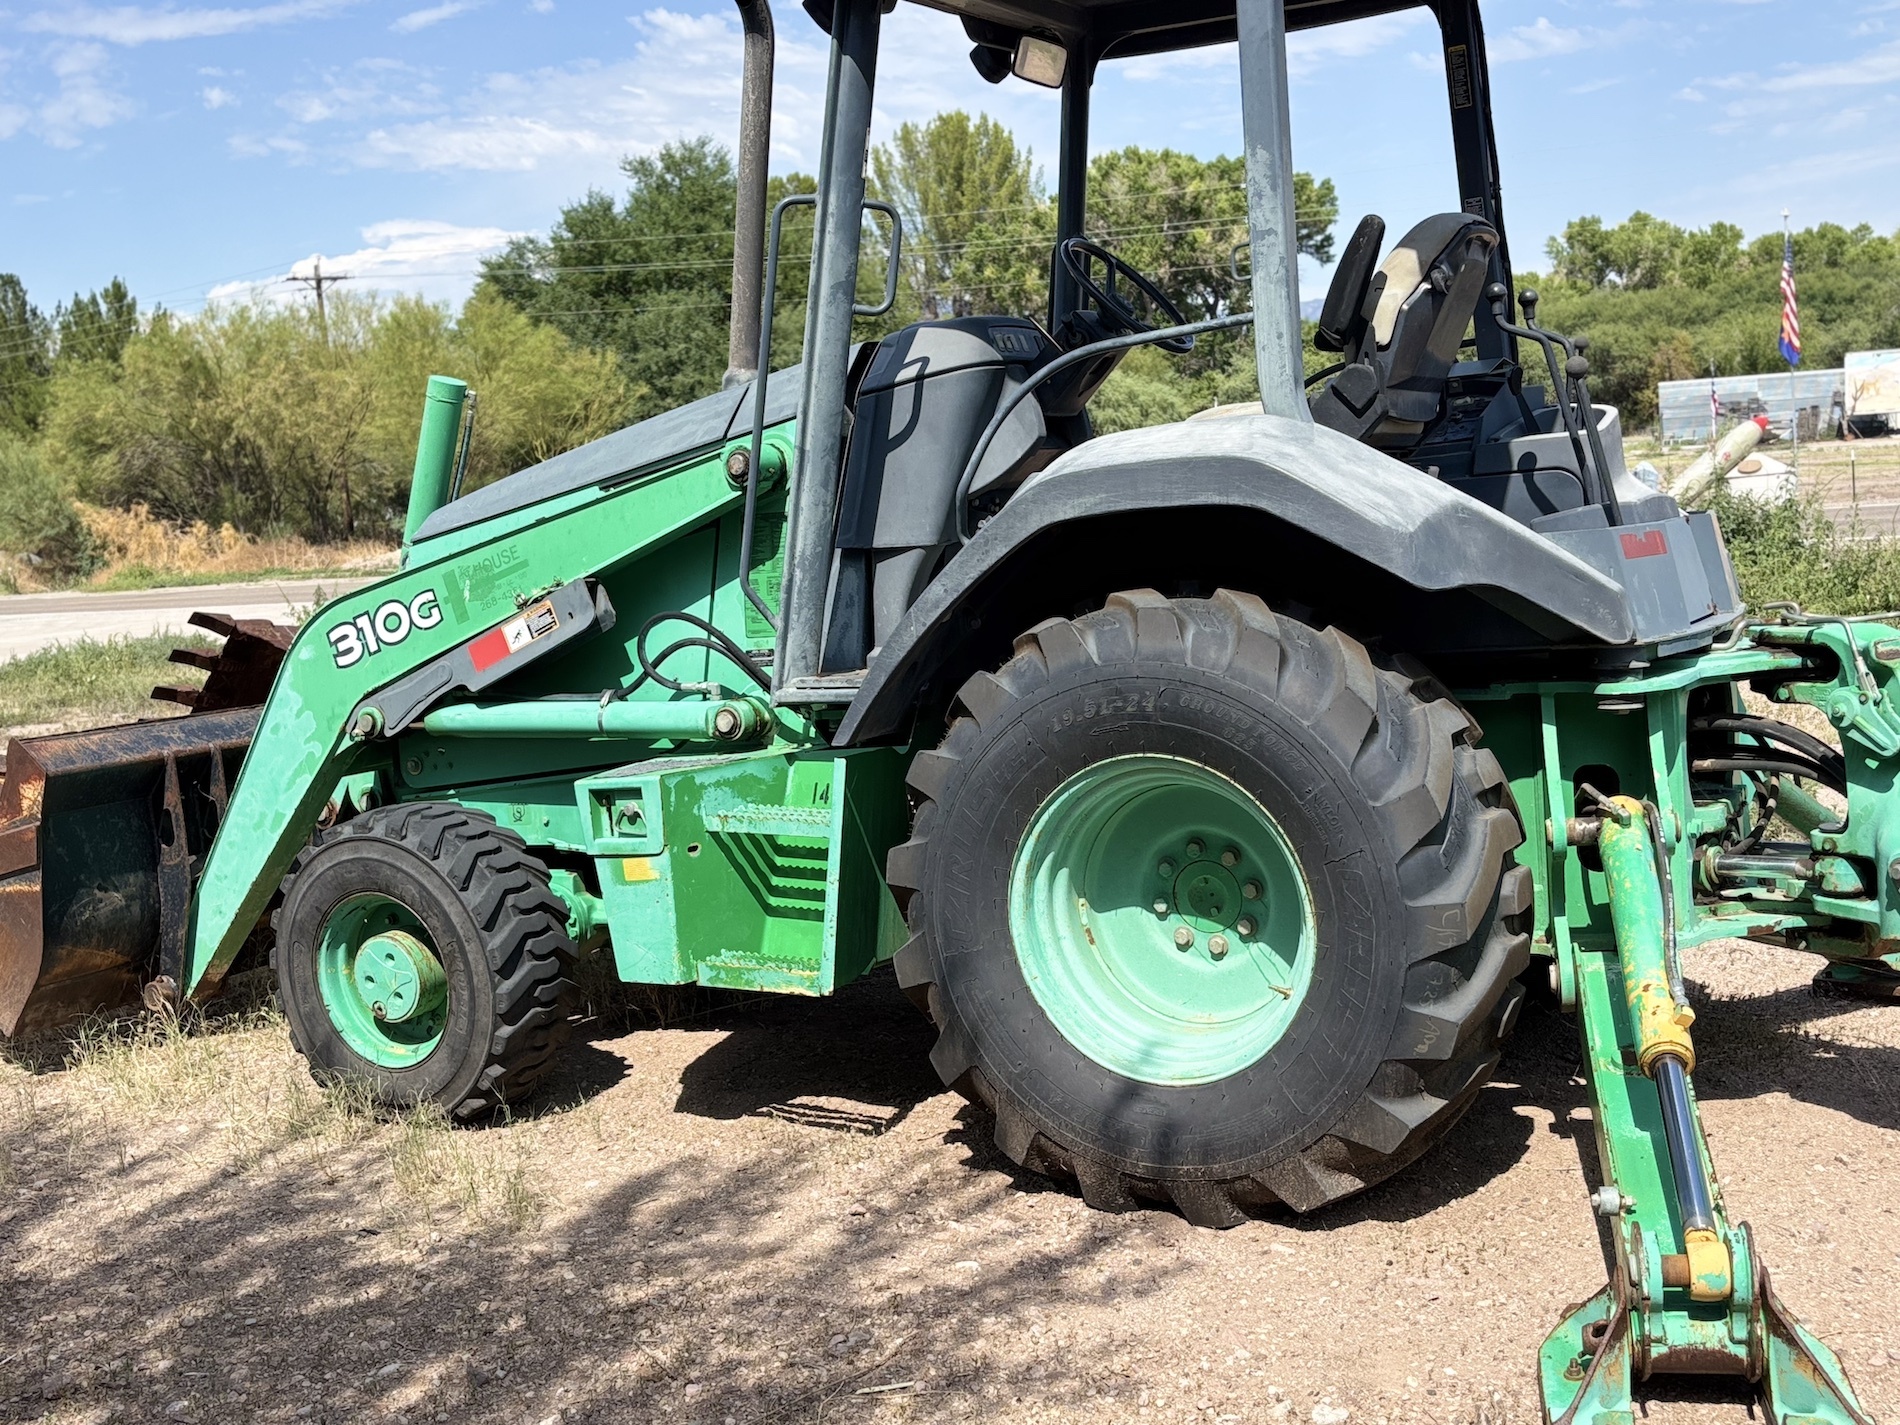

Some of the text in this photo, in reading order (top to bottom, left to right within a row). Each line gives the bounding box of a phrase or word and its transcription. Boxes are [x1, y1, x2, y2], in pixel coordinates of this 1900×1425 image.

[327, 589, 444, 669] 310G
[1179, 694, 1252, 729] GROUND
[812, 781, 831, 804] 14
